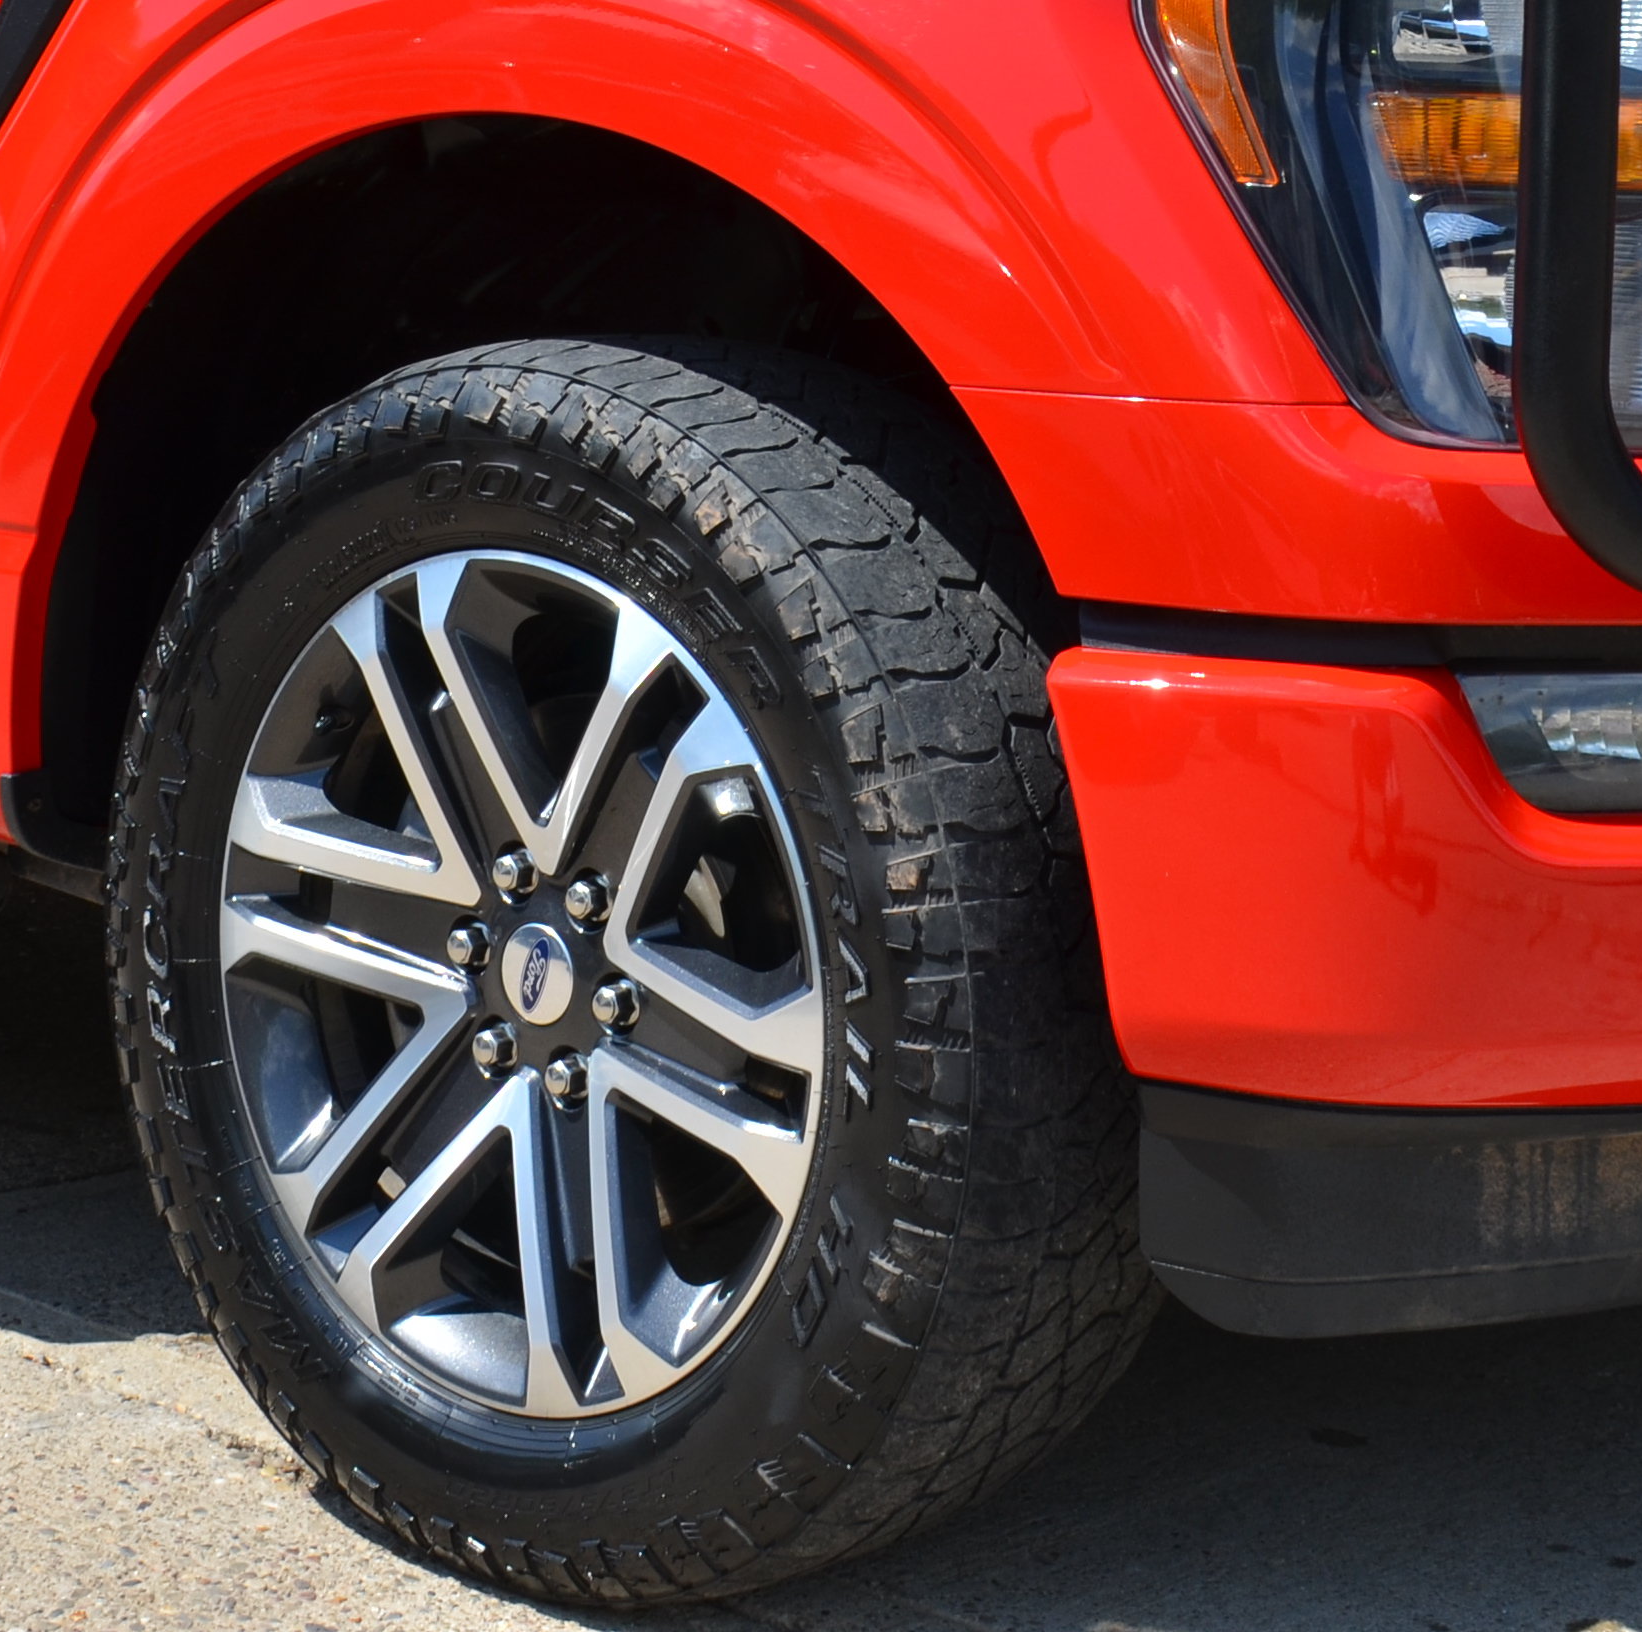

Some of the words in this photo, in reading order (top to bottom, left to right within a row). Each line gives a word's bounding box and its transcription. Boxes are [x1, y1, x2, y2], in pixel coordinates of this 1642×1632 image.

[412, 459, 784, 713] COURSER
[521, 947, 547, 1002] Ford
[782, 764, 874, 1119] TRAIL
